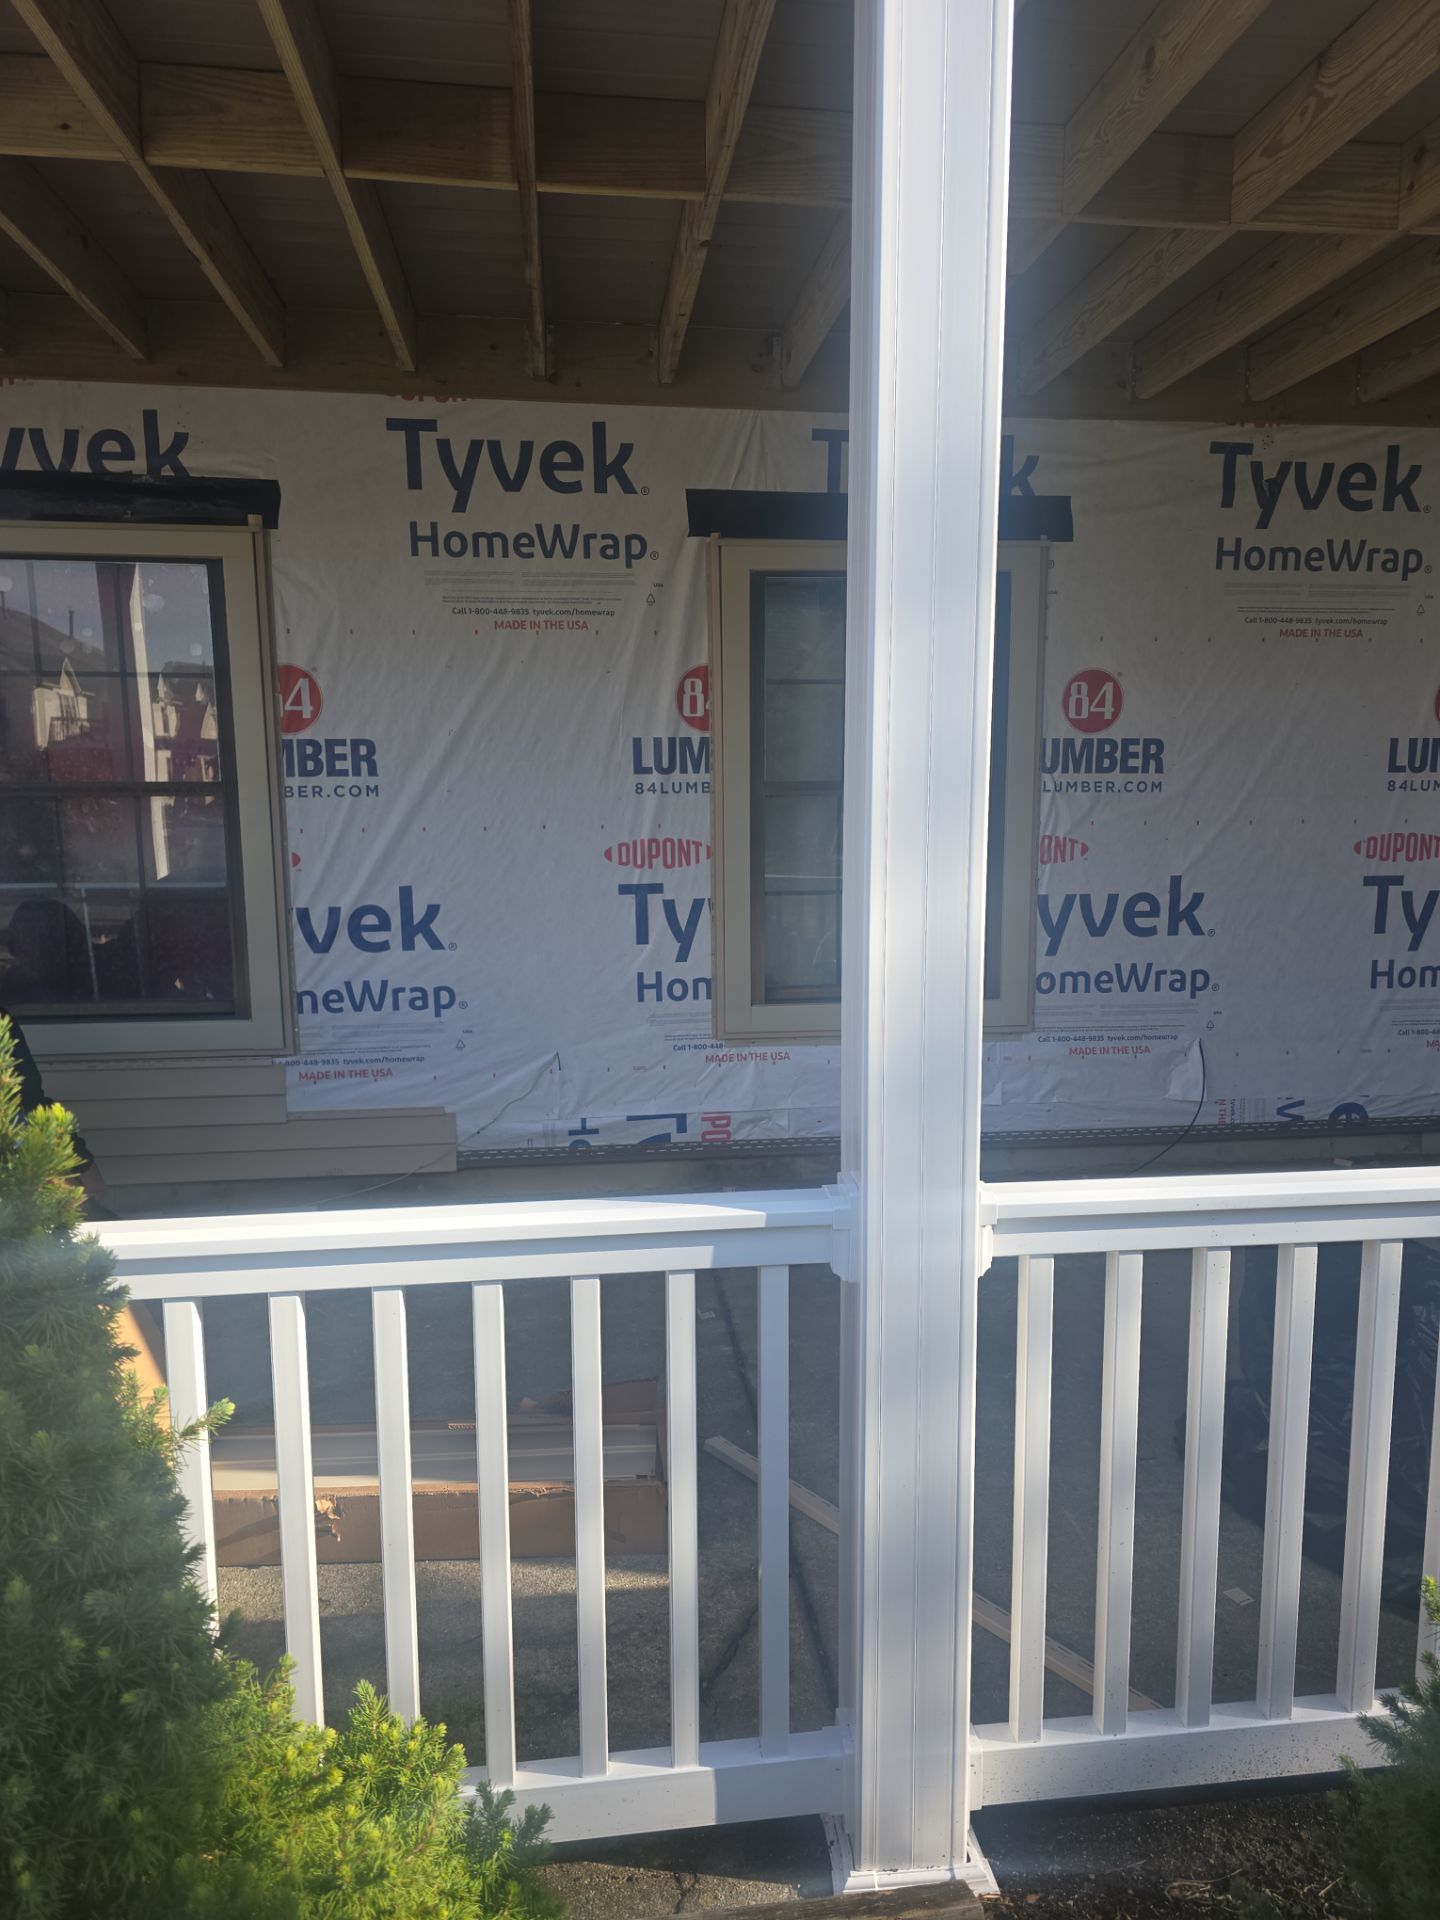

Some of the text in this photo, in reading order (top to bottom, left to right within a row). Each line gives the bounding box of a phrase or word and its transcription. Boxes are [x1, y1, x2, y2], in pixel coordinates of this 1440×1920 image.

[386, 418, 638, 513] Tyvek
[1209, 441, 1422, 529] Tyvek
[409, 521, 648, 569] HomeWrap
[1215, 537, 1424, 582] HomeWrap
[452, 607, 467, 615] Call
[494, 620, 589, 630] MADE IN THE USA
[1279, 628, 1363, 638] MADE IN THE USA
[281, 677, 313, 719] 4
[1068, 681, 1115, 720] 84
[617, 837, 703, 870] DUPONT
[705, 1051, 791, 1063] MADE IN THE USA
[1069, 1046, 1151, 1056] MADE IN THE USA
[298, 1068, 393, 1081] MADE IN THE USA
